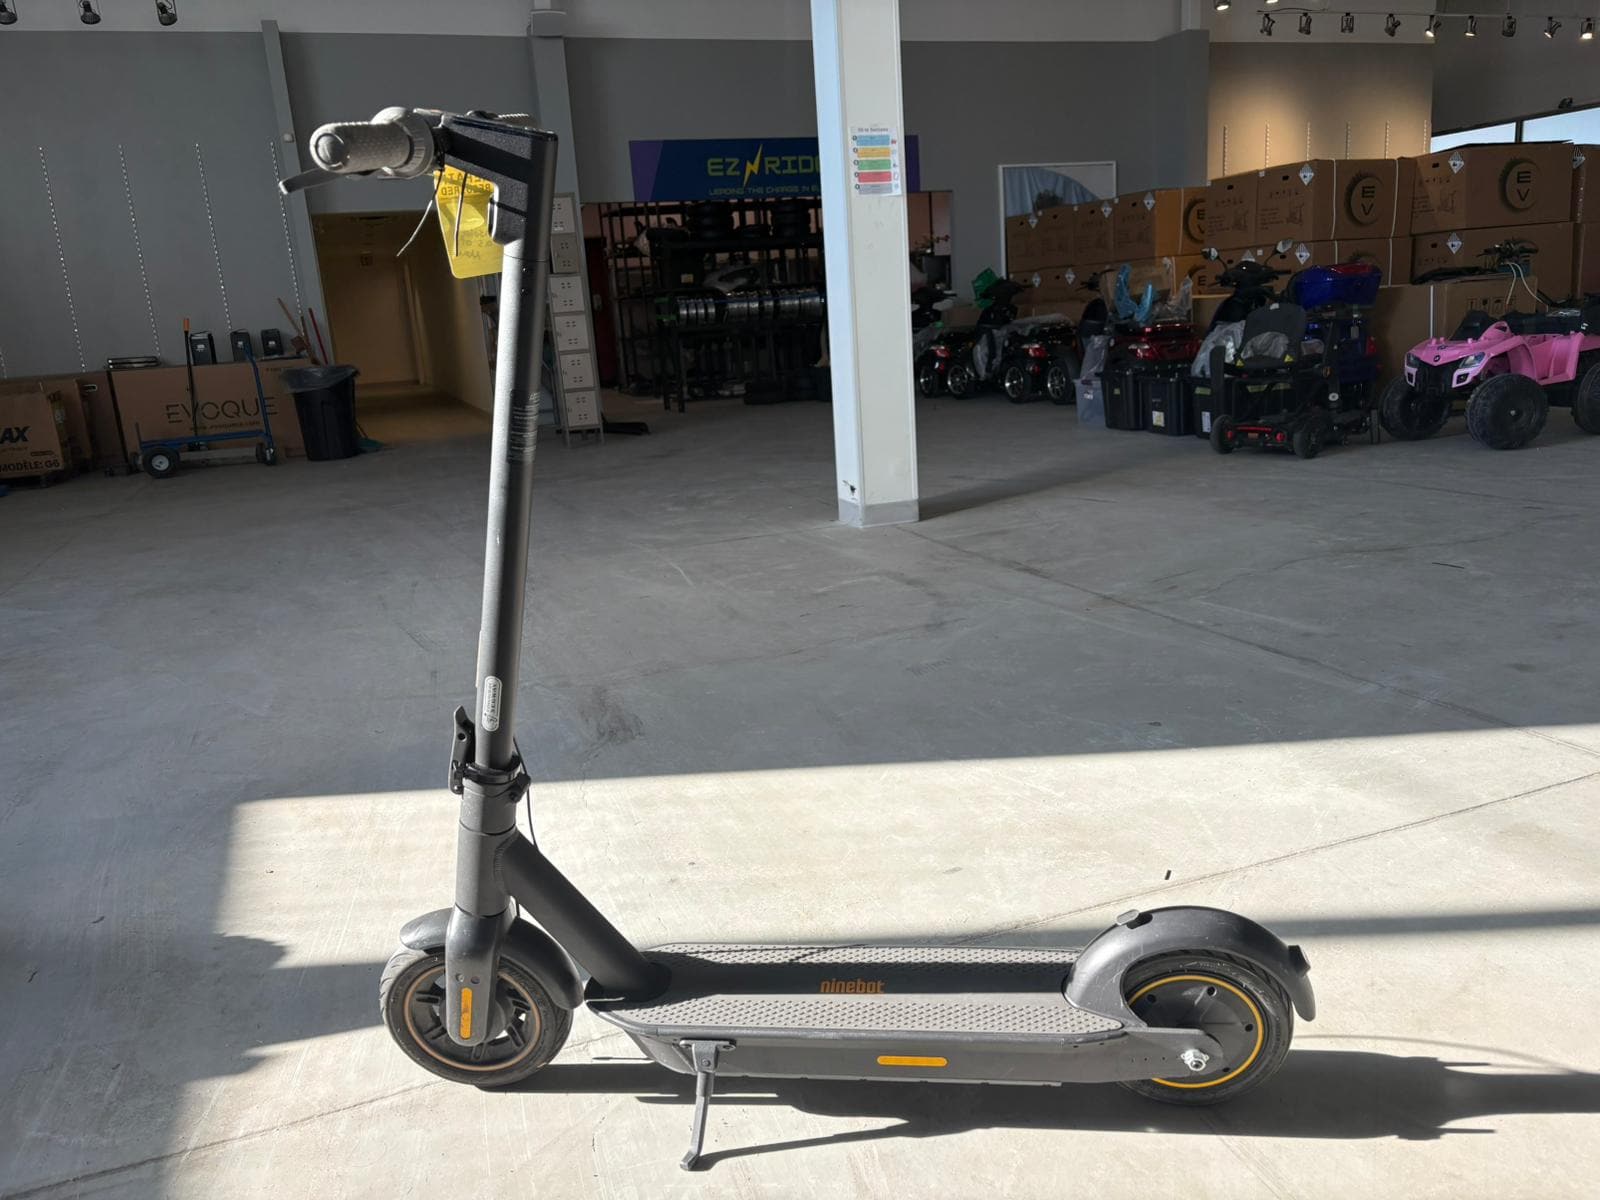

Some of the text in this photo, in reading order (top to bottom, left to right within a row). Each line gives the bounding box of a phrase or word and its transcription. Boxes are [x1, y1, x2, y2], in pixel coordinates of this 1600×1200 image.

[707, 154, 820, 176] EZ RID
[166, 396, 278, 424] EVOQUE
[820, 978, 886, 994] ninebot
